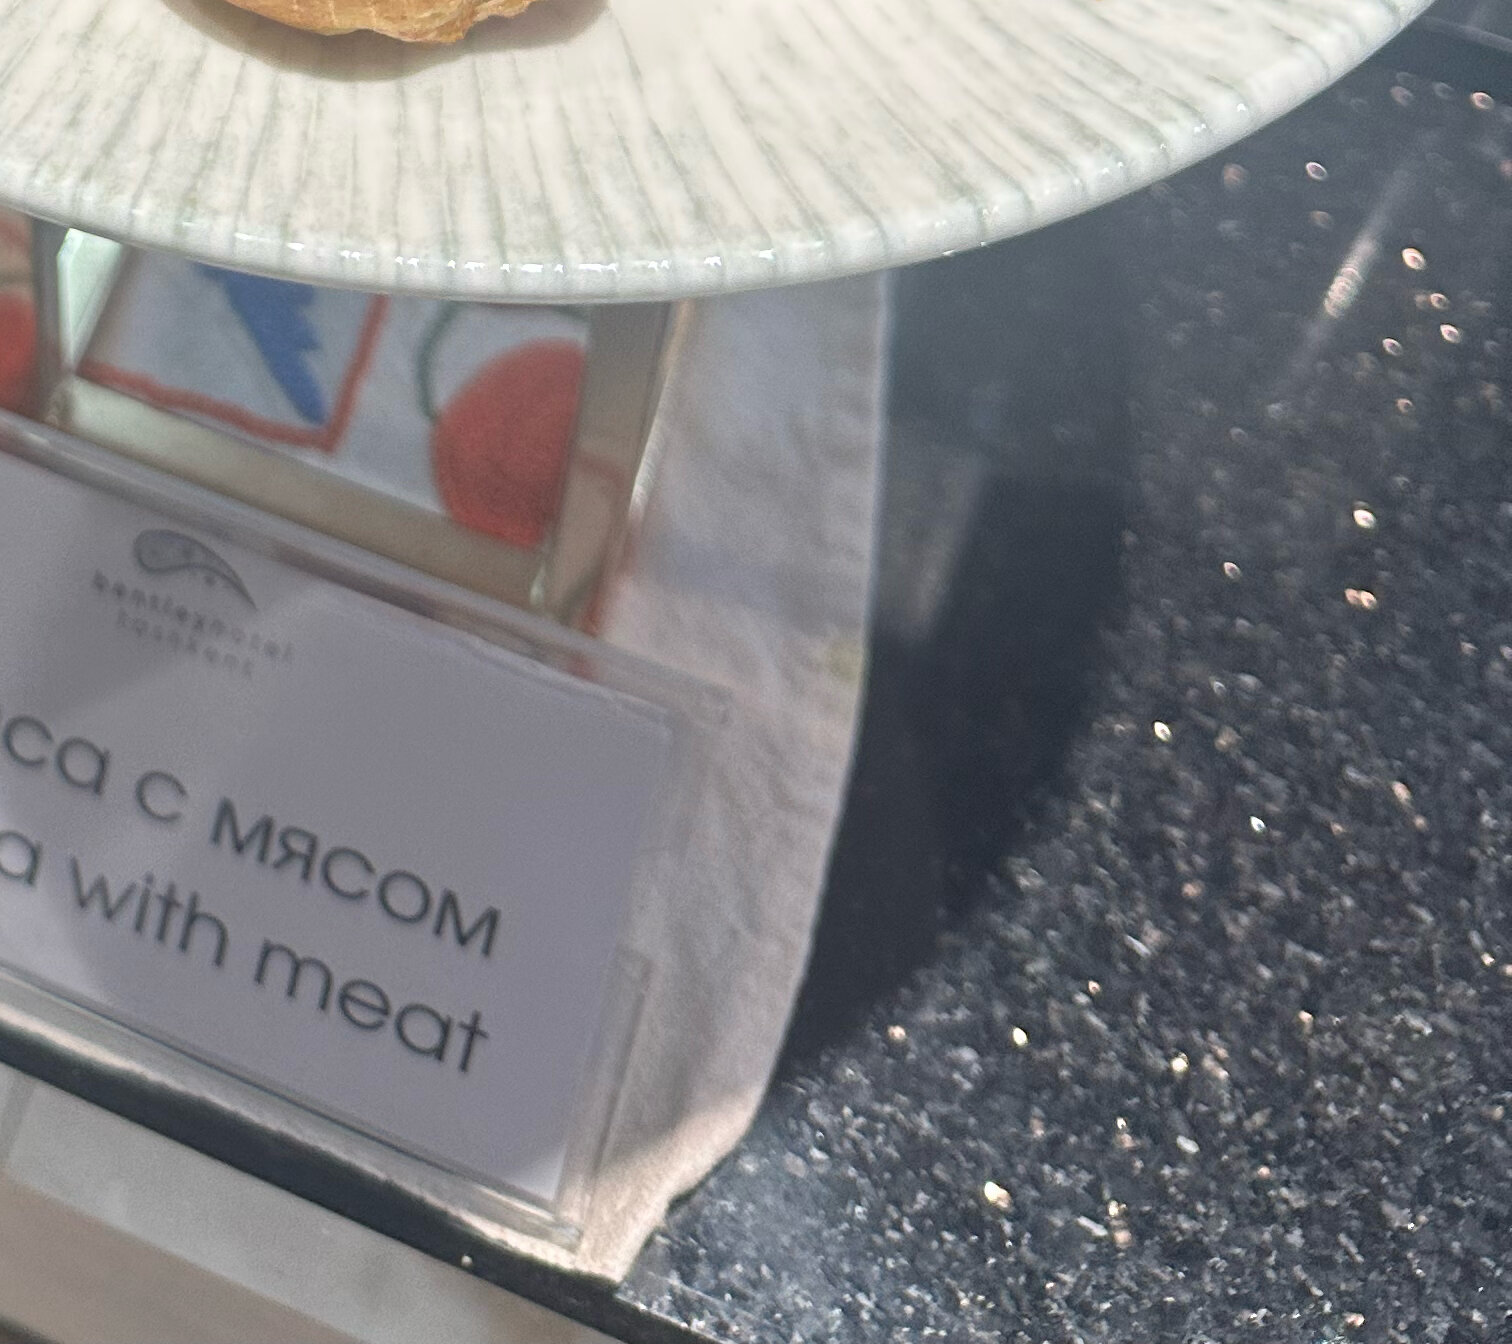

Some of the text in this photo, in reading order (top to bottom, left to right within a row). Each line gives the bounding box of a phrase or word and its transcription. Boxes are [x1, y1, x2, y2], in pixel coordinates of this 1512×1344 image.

[69, 855, 230, 968] with
[253, 936, 490, 1074] meat
[135, 769, 187, 823] с
[210, 796, 502, 958] мясом
